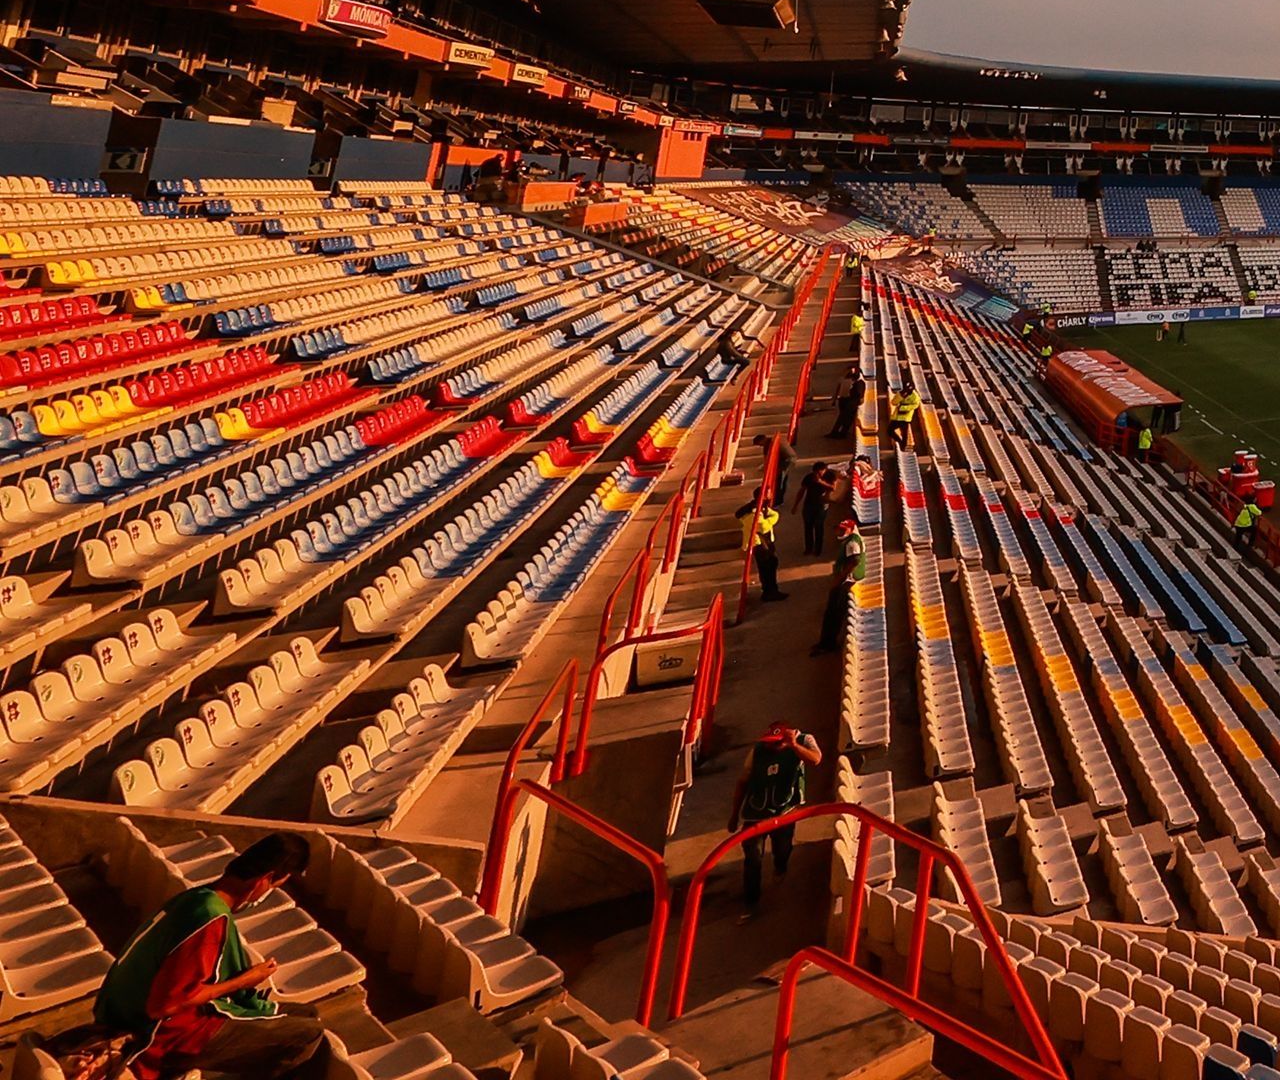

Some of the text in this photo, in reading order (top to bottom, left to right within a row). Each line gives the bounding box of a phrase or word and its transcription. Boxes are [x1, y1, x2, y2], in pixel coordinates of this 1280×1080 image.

[350, 4, 383, 26] MÓNICA
[1116, 282, 1232, 306] FIFA
[1057, 316, 1087, 328] CHARLY
